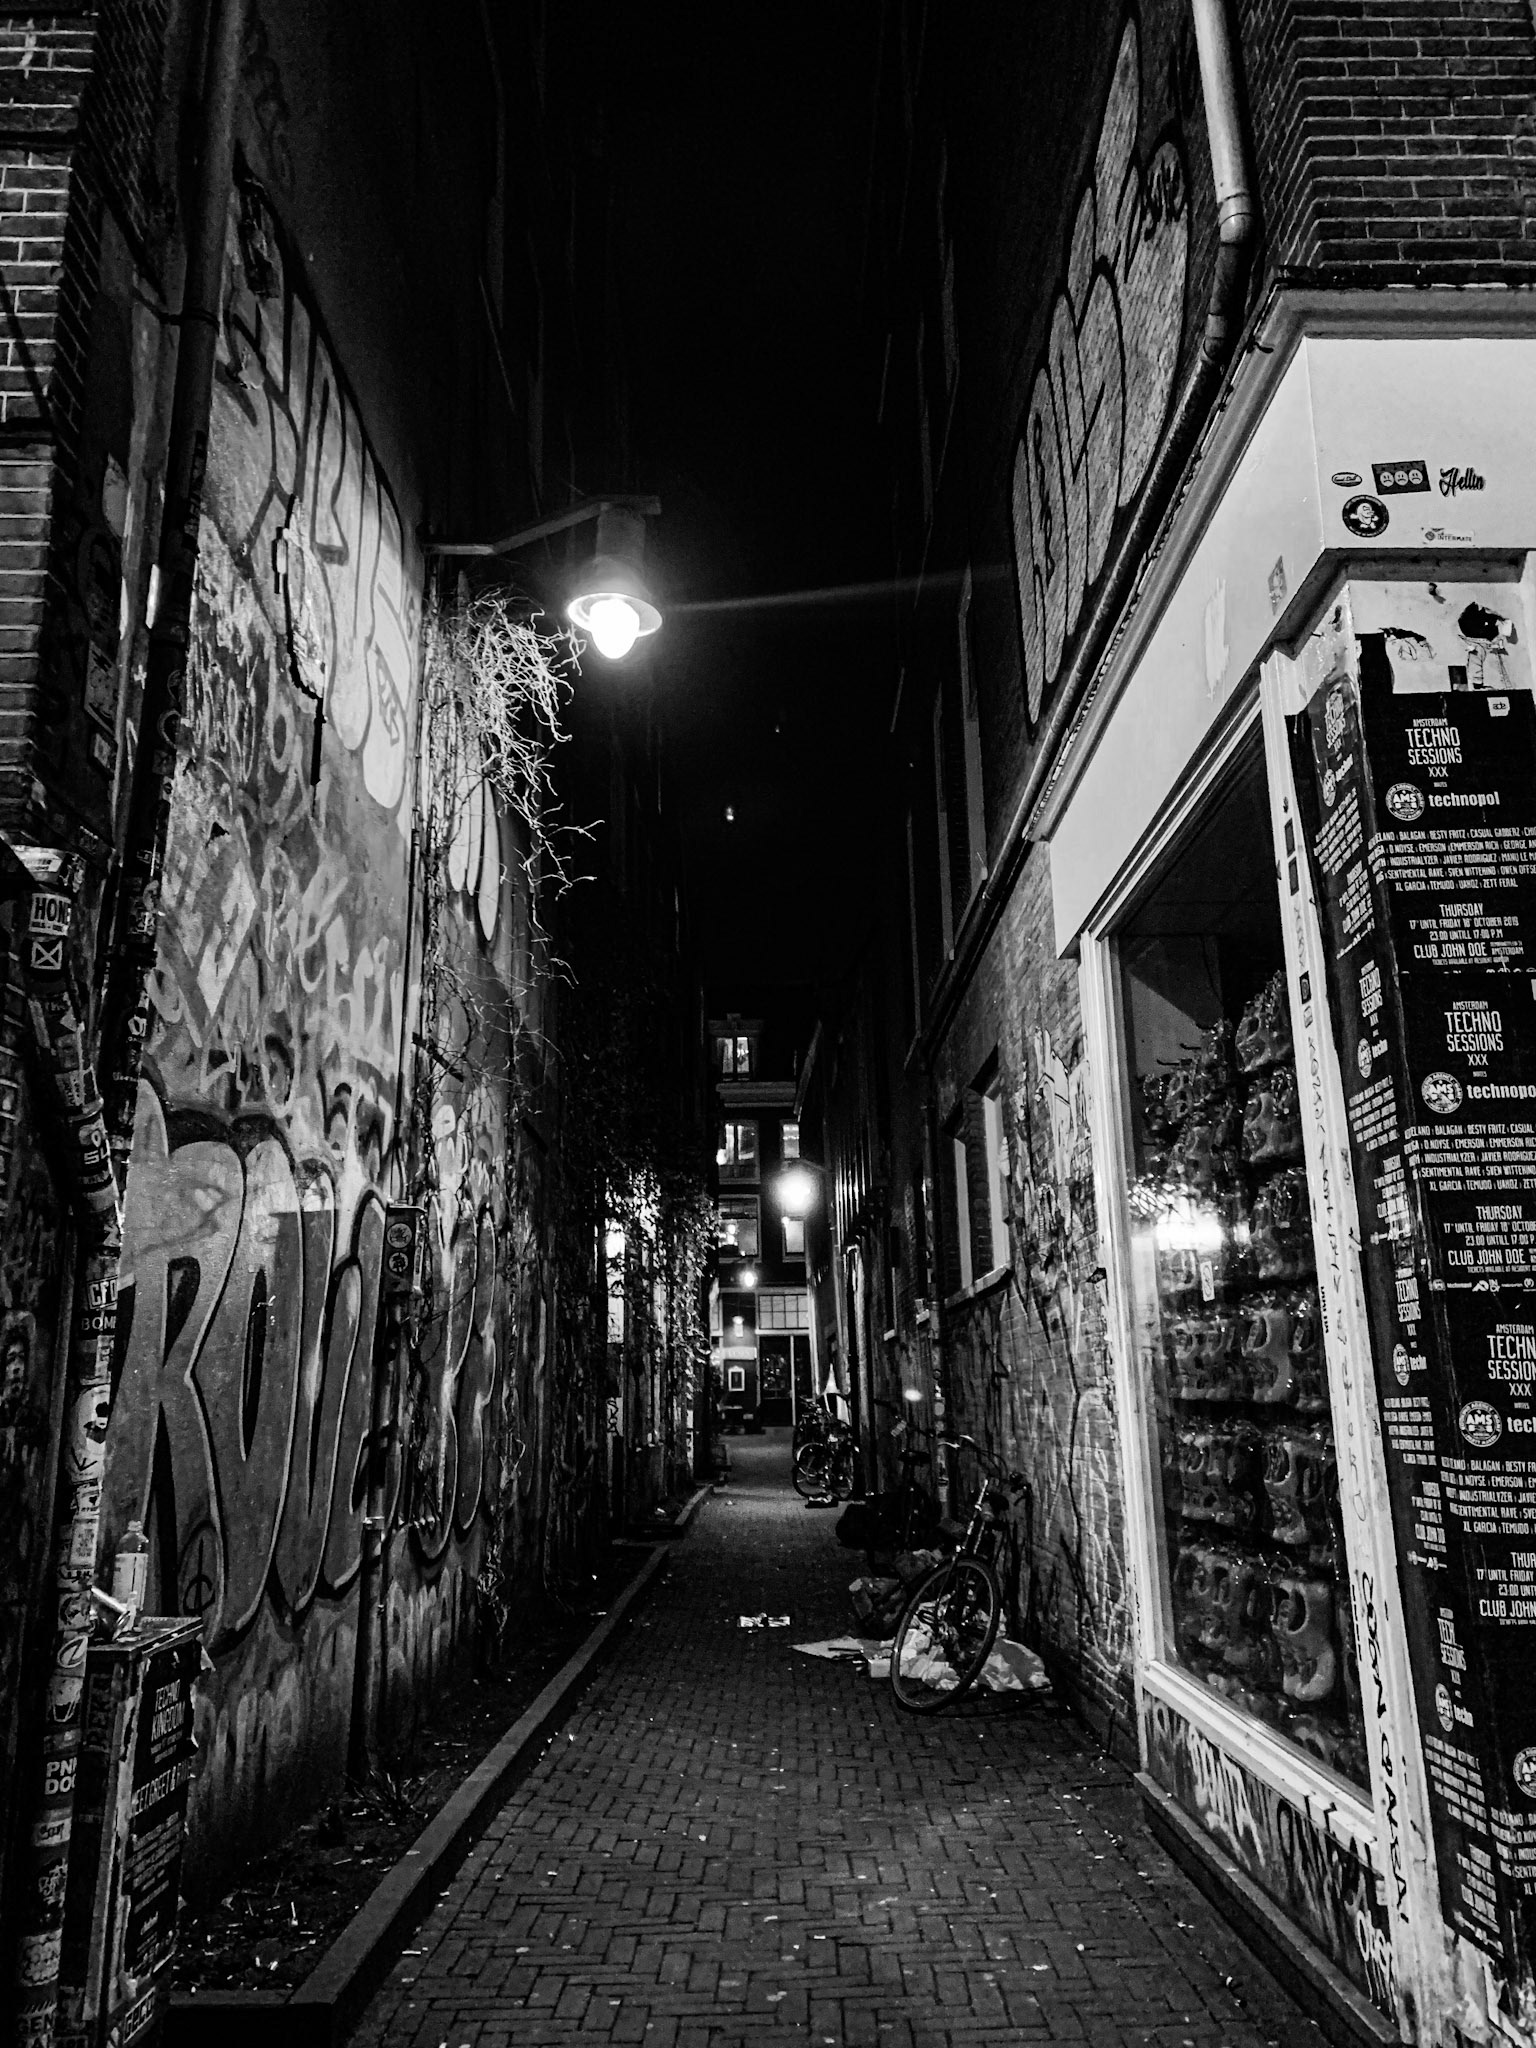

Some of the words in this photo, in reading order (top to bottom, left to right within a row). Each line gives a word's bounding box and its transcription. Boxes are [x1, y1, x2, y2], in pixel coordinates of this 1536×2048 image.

[1413, 718, 1448, 727] AMSTERDAM
[1405, 727, 1461, 748] TECHNO
[1408, 747, 1463, 765] SESSIONS
[1428, 766, 1449, 777] XXX
[1393, 793, 1417, 803] AMS
[1428, 791, 1500, 807] technopol
[1439, 903, 1484, 917] THURSDAY
[1473, 917, 1502, 927] OCTOBER
[1413, 944, 1438, 959] CLUB
[1441, 943, 1466, 958] JOHN
[1468, 942, 1488, 957] DOE
[1453, 1001, 1488, 1010] AMSTERDAM
[1444, 1010, 1502, 1033] TECHNO
[1446, 1033, 1504, 1052] SESSIONS
[1467, 1053, 1489, 1066] XXX
[1430, 1083, 1454, 1094] AMS
[1475, 1205, 1522, 1220] THURSDAY
[1447, 1250, 1474, 1265] CLUB
[1477, 1249, 1503, 1265] JOHN
[1505, 1249, 1526, 1264] DOE
[1395, 1277, 1419, 1303] TECHNO
[1496, 1324, 1534, 1334] AMSTERDAM
[1508, 1383, 1532, 1396] XXX
[1466, 1413, 1493, 1425] AMS
[1479, 1599, 1507, 1617] CLUB
